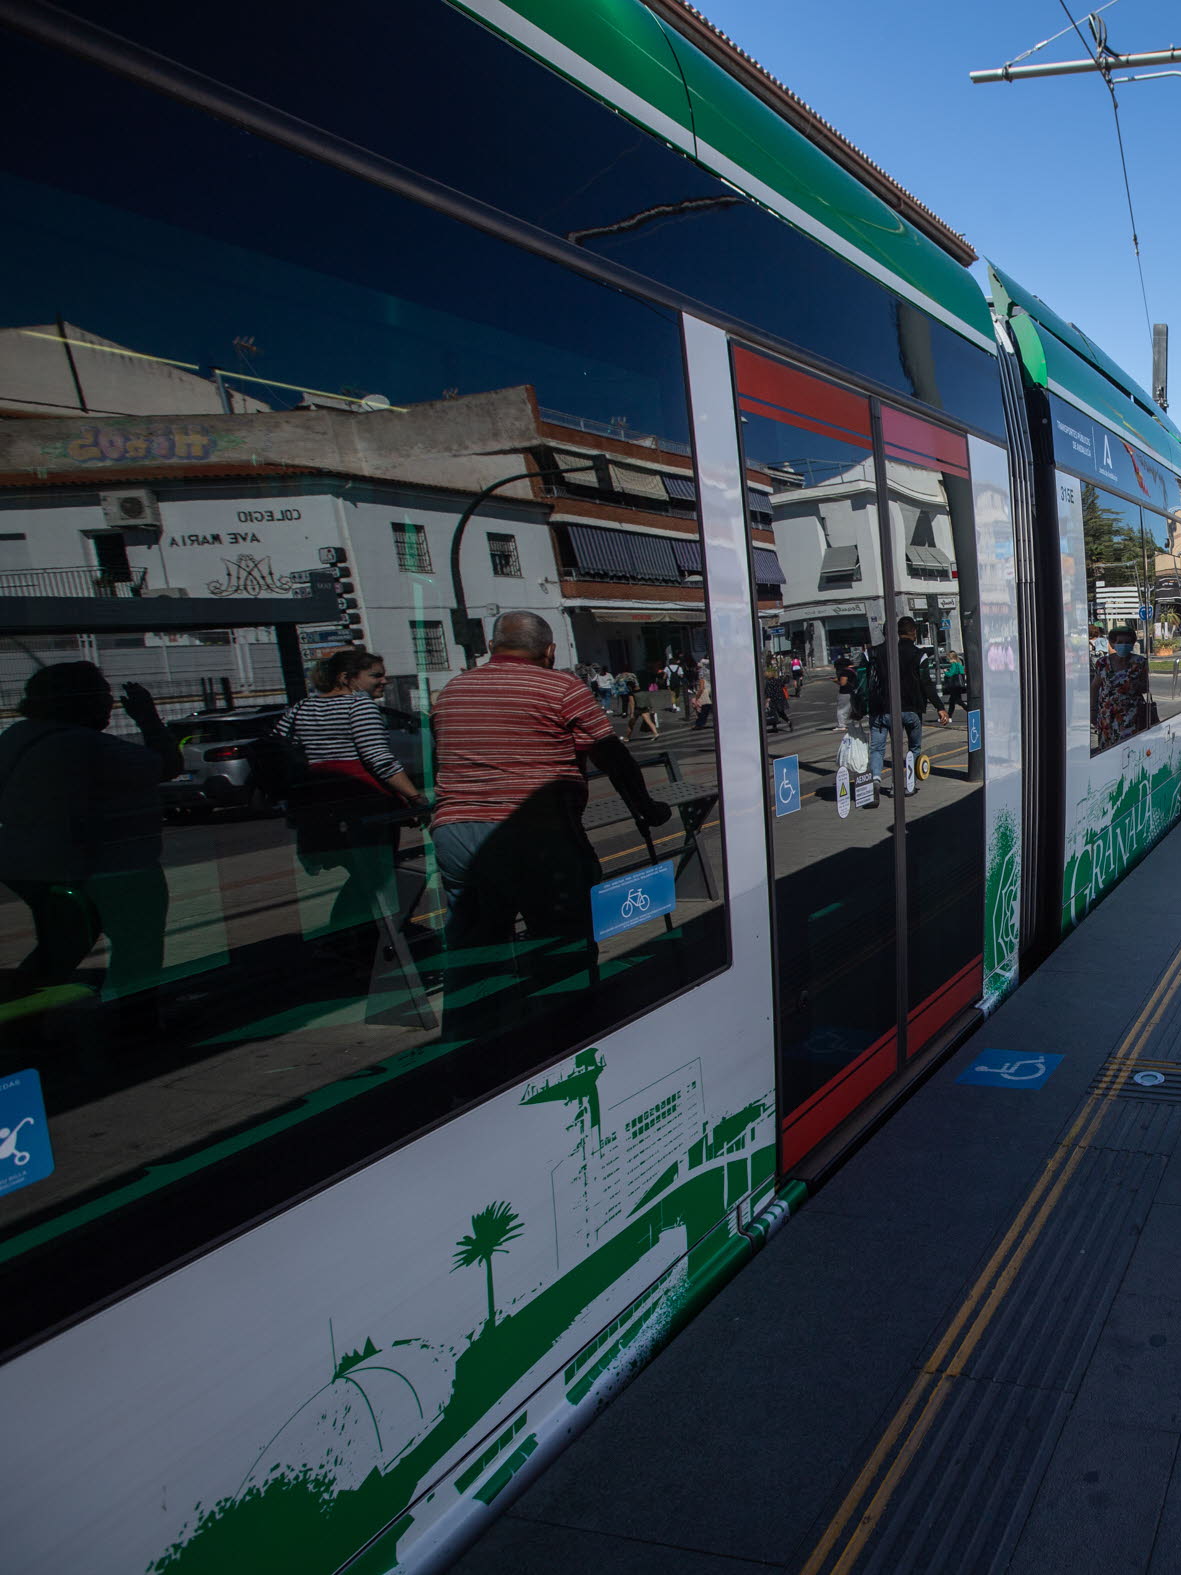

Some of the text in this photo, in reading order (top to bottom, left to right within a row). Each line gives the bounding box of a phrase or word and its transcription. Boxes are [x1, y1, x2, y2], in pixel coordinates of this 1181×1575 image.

[1060, 485, 1075, 504] 315E
[855, 772, 873, 784] AENOR
[1070, 778, 1154, 926] GRANADA
